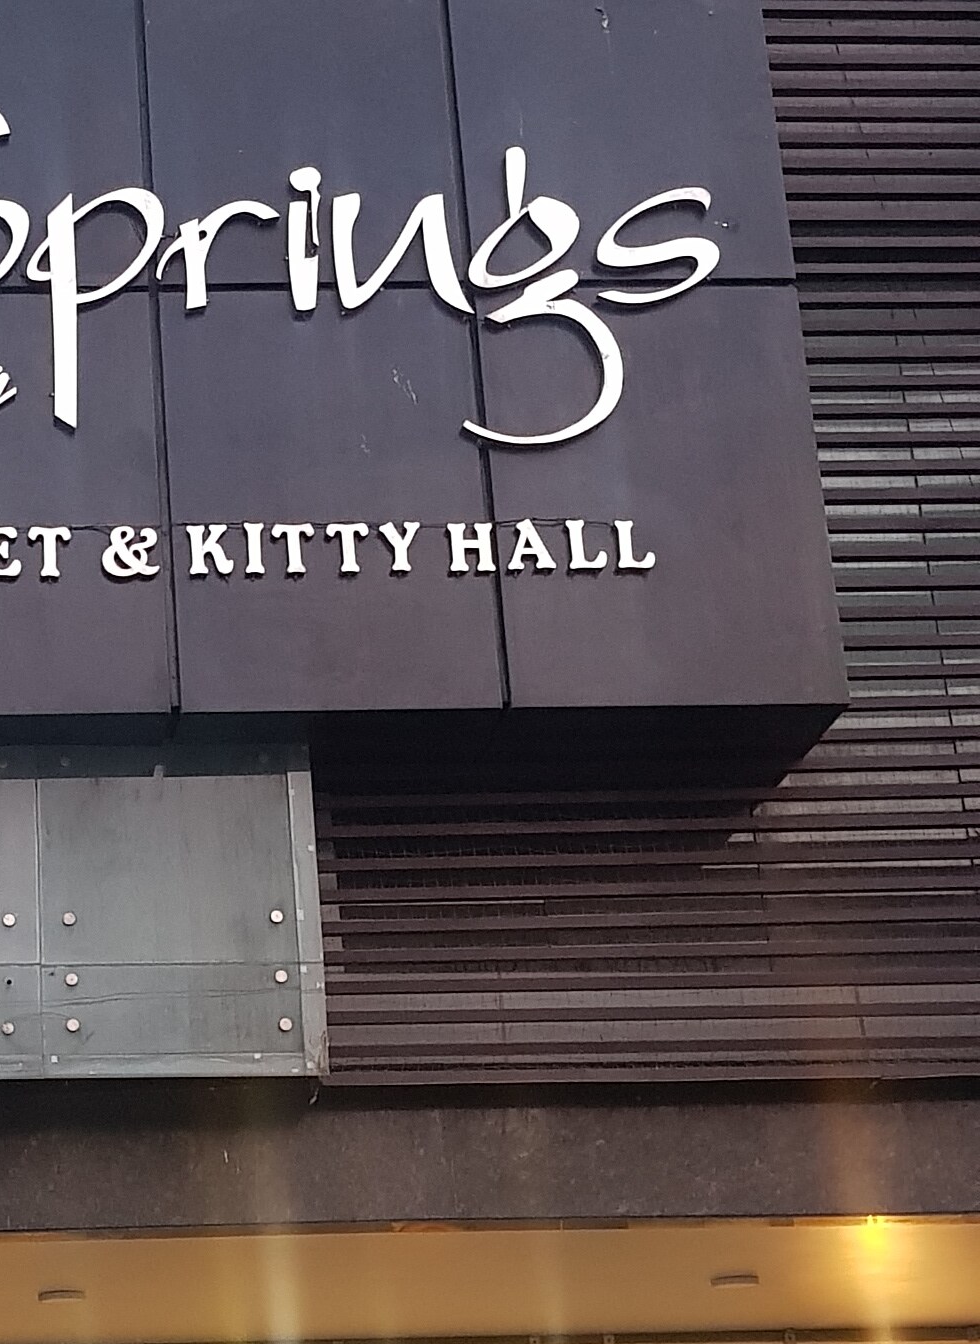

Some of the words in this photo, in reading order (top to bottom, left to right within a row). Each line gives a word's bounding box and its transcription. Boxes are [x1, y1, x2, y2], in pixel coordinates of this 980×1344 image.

[101, 525, 162, 579] &
[185, 520, 422, 577] KITTY
[447, 517, 658, 575] HALL
